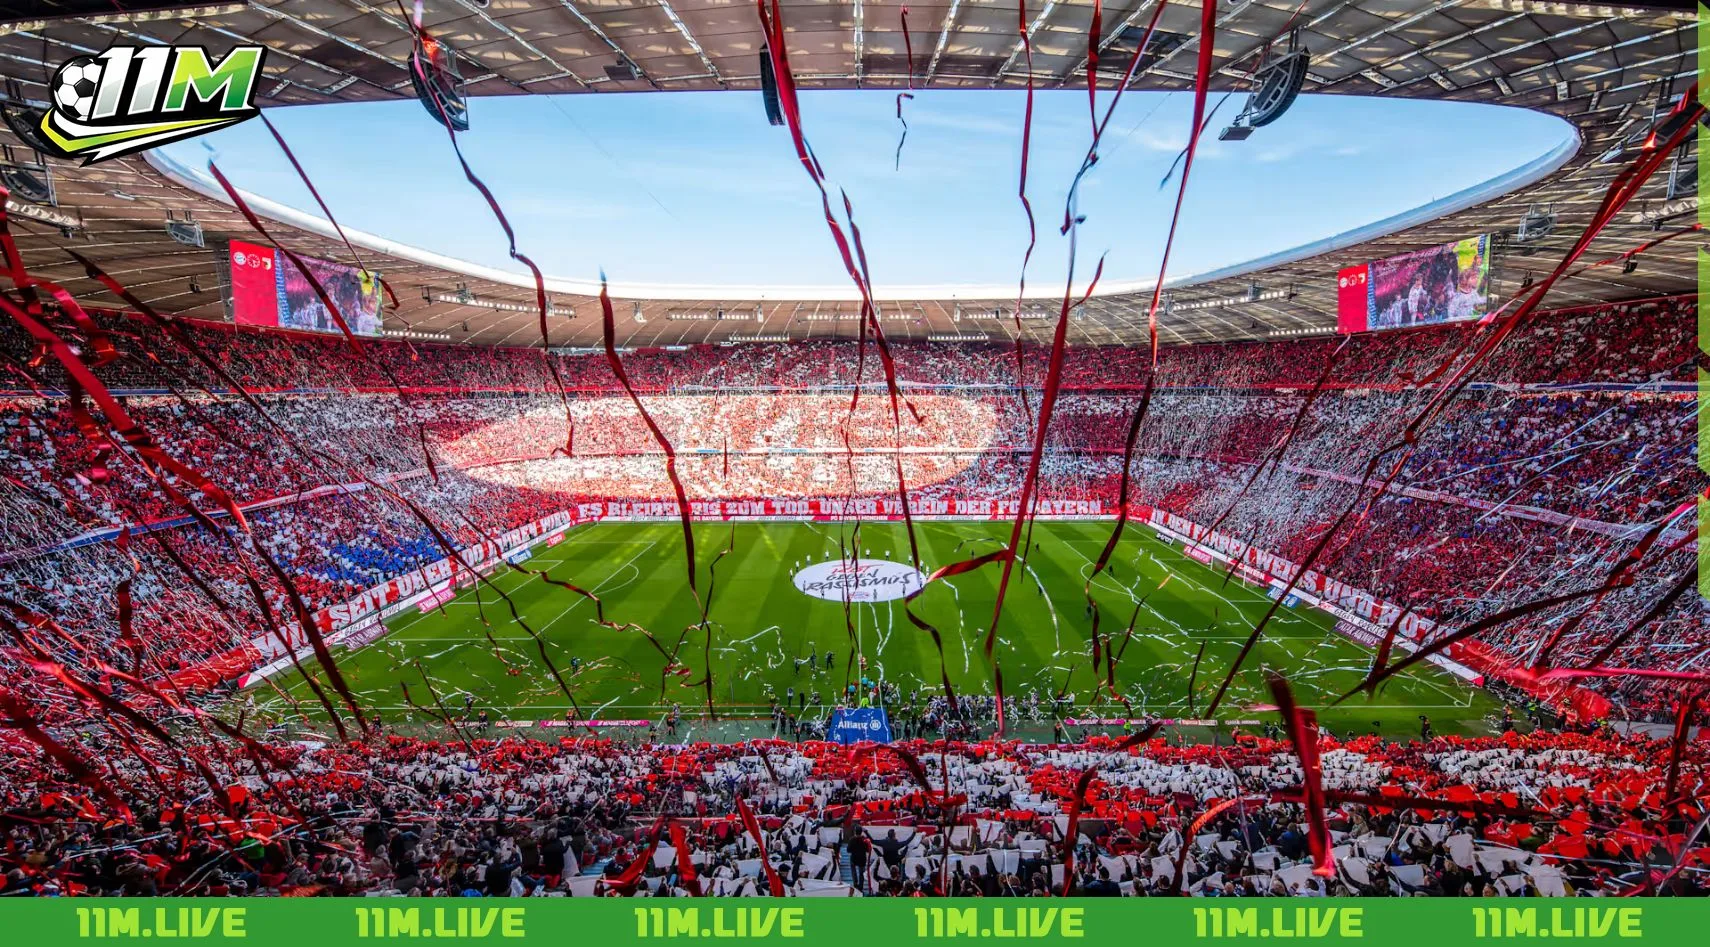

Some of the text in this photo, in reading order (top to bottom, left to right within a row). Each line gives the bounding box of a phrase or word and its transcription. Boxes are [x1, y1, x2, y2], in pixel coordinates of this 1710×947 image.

[726, 501, 764, 515] ZUM
[883, 500, 948, 514] VEREIN
[956, 500, 990, 514] DER
[329, 585, 391, 630] SEIT
[1324, 577, 1375, 617] UND
[838, 720, 868, 730] Allianz
